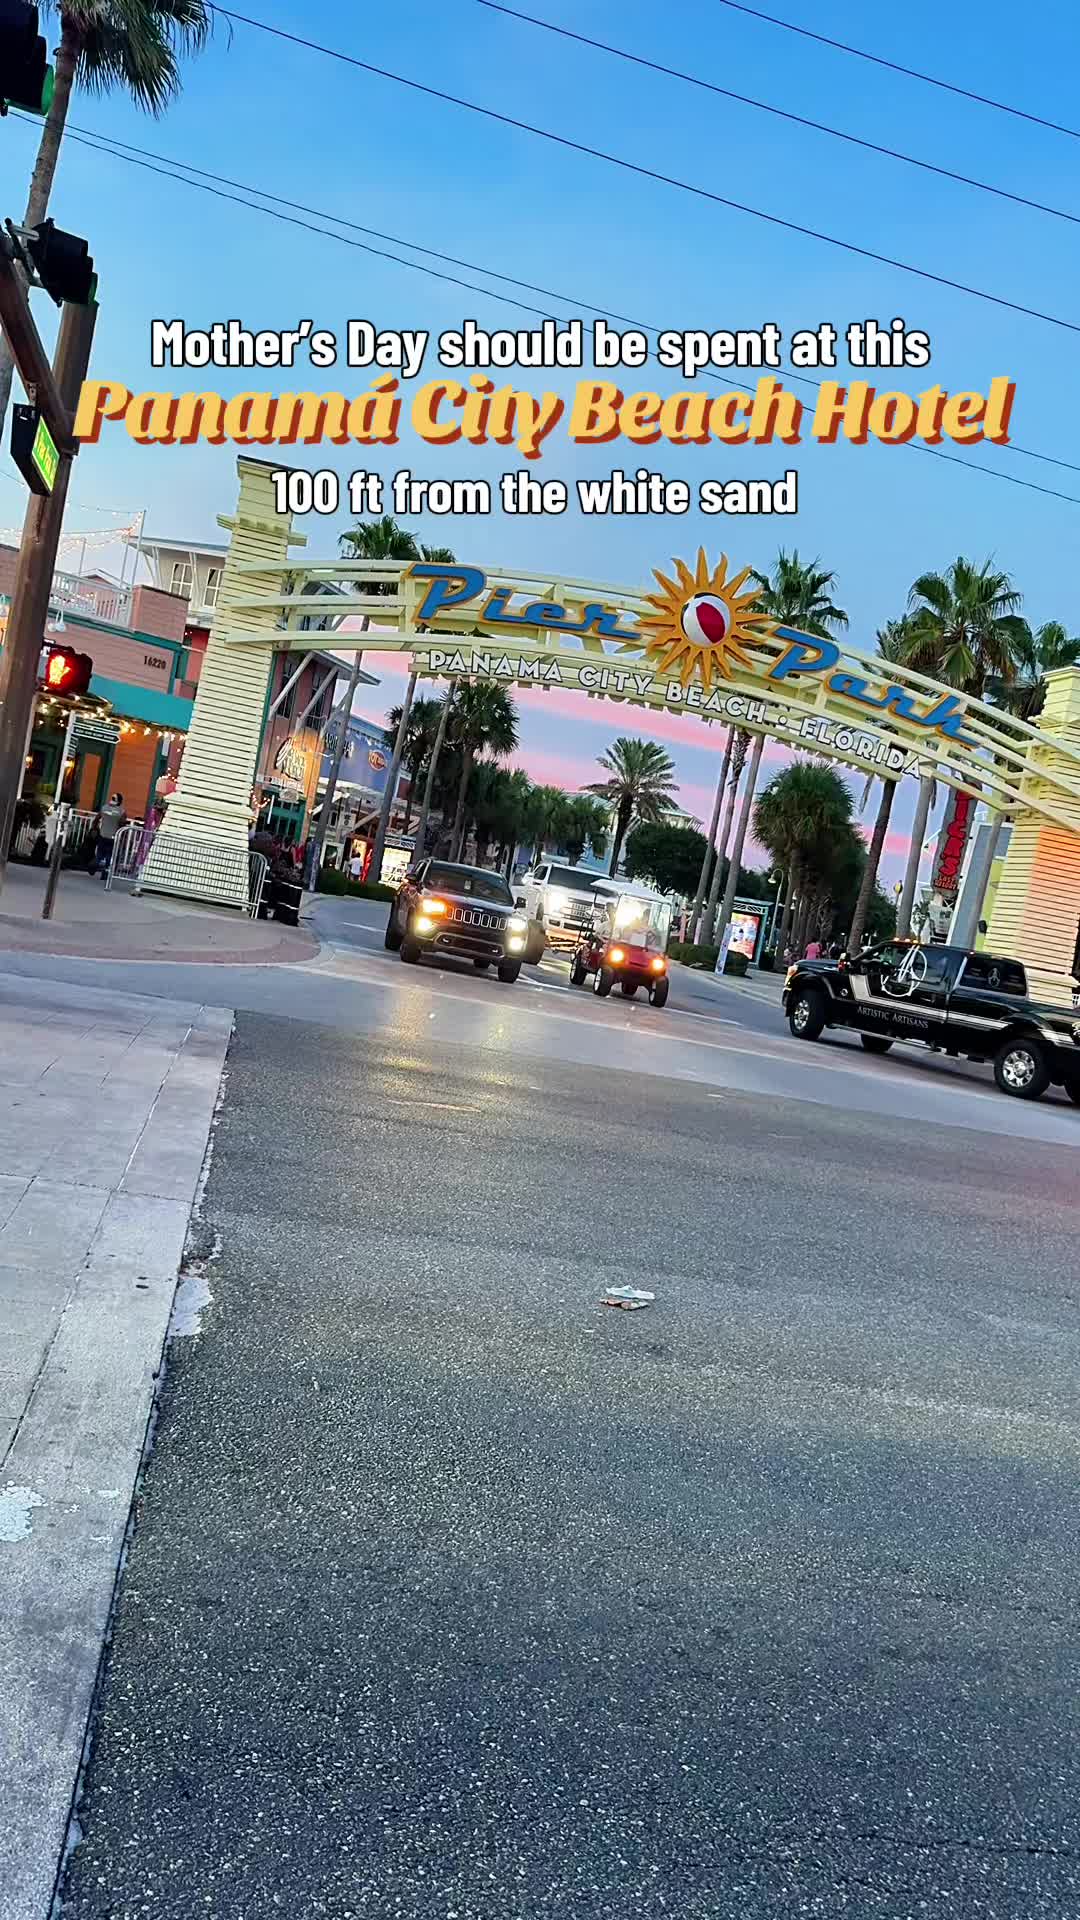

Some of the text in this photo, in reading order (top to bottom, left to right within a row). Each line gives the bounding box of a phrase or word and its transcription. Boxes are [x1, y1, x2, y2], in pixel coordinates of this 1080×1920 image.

[144, 655, 167, 670] 16220
[403, 562, 984, 749] Pier Park
[428, 648, 922, 779] PANAMA CITY BEACH FLORIDA
